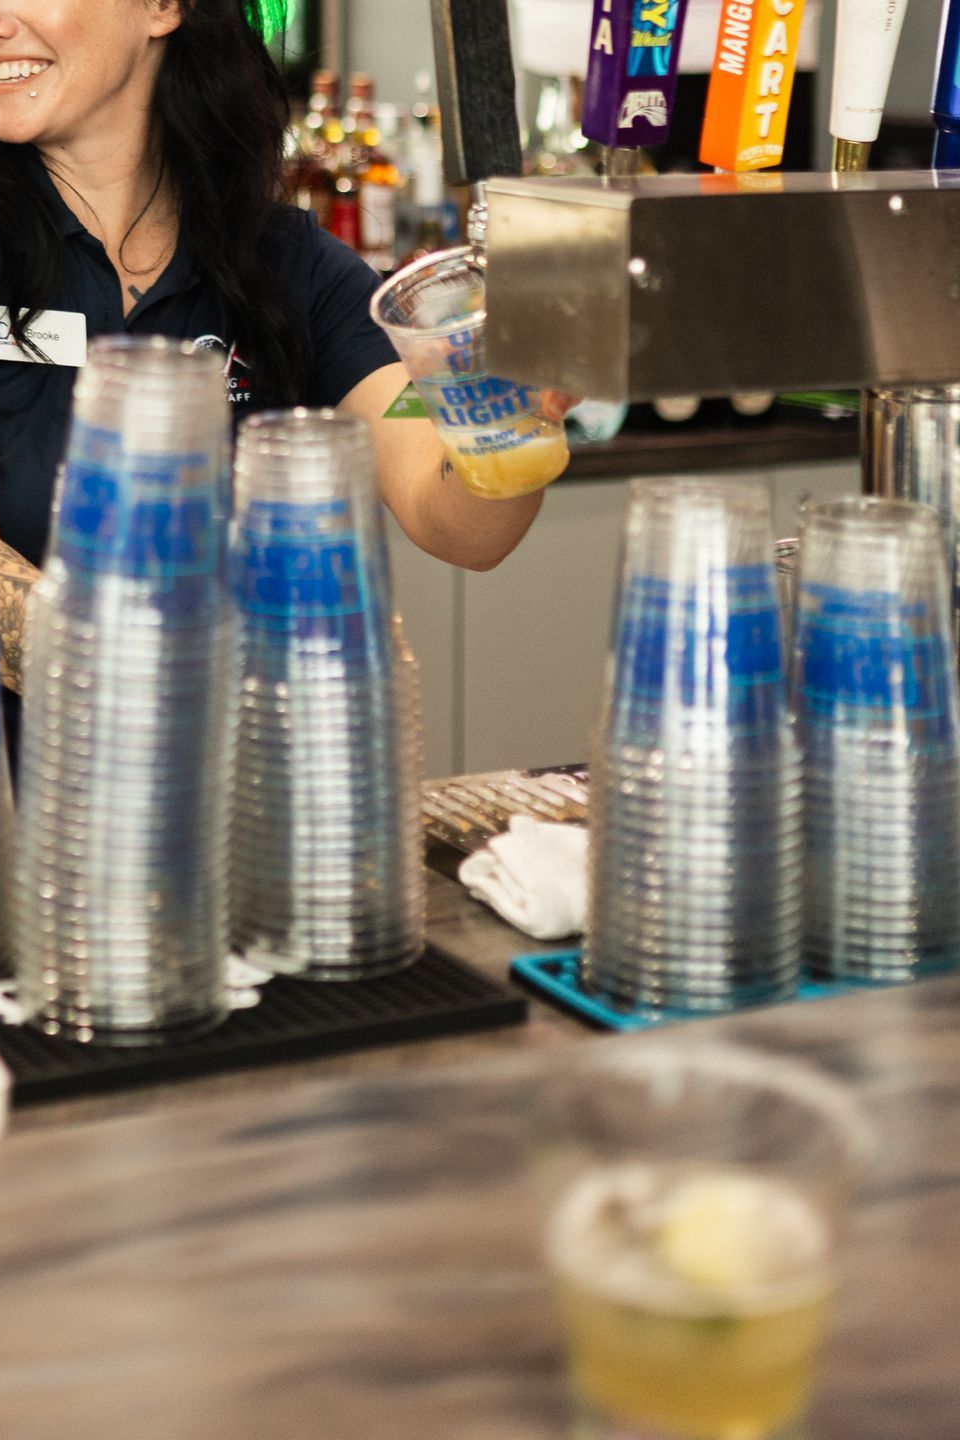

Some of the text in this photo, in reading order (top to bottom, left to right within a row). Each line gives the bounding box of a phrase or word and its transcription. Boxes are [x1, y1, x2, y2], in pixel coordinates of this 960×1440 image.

[26, 328, 60, 342] Brooke
[438, 385, 533, 427] LIGHT
[474, 428, 516, 447] ENJOY
